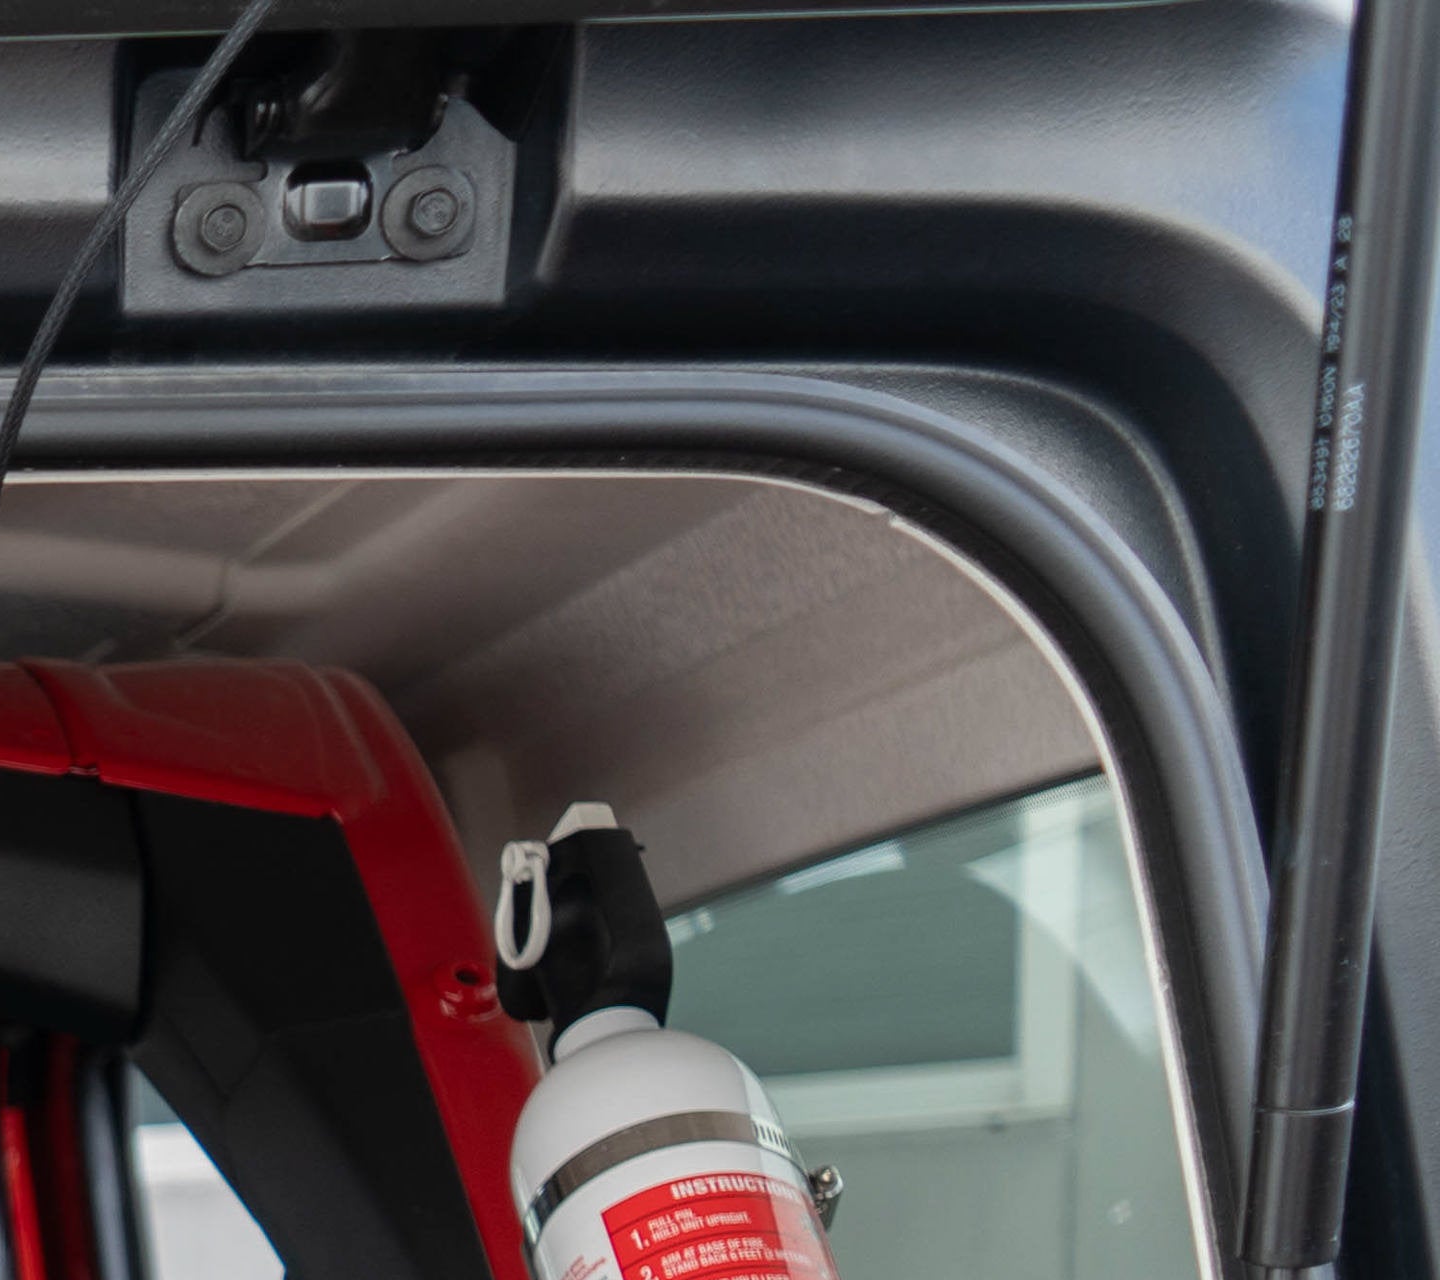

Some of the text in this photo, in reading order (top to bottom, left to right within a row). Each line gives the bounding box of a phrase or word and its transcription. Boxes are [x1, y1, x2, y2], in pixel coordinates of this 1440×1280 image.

[698, 1240, 726, 1255] BASE
[664, 1258, 700, 1279] STAND
[700, 1252, 730, 1268] BACK
[739, 1249, 762, 1261] FEET
